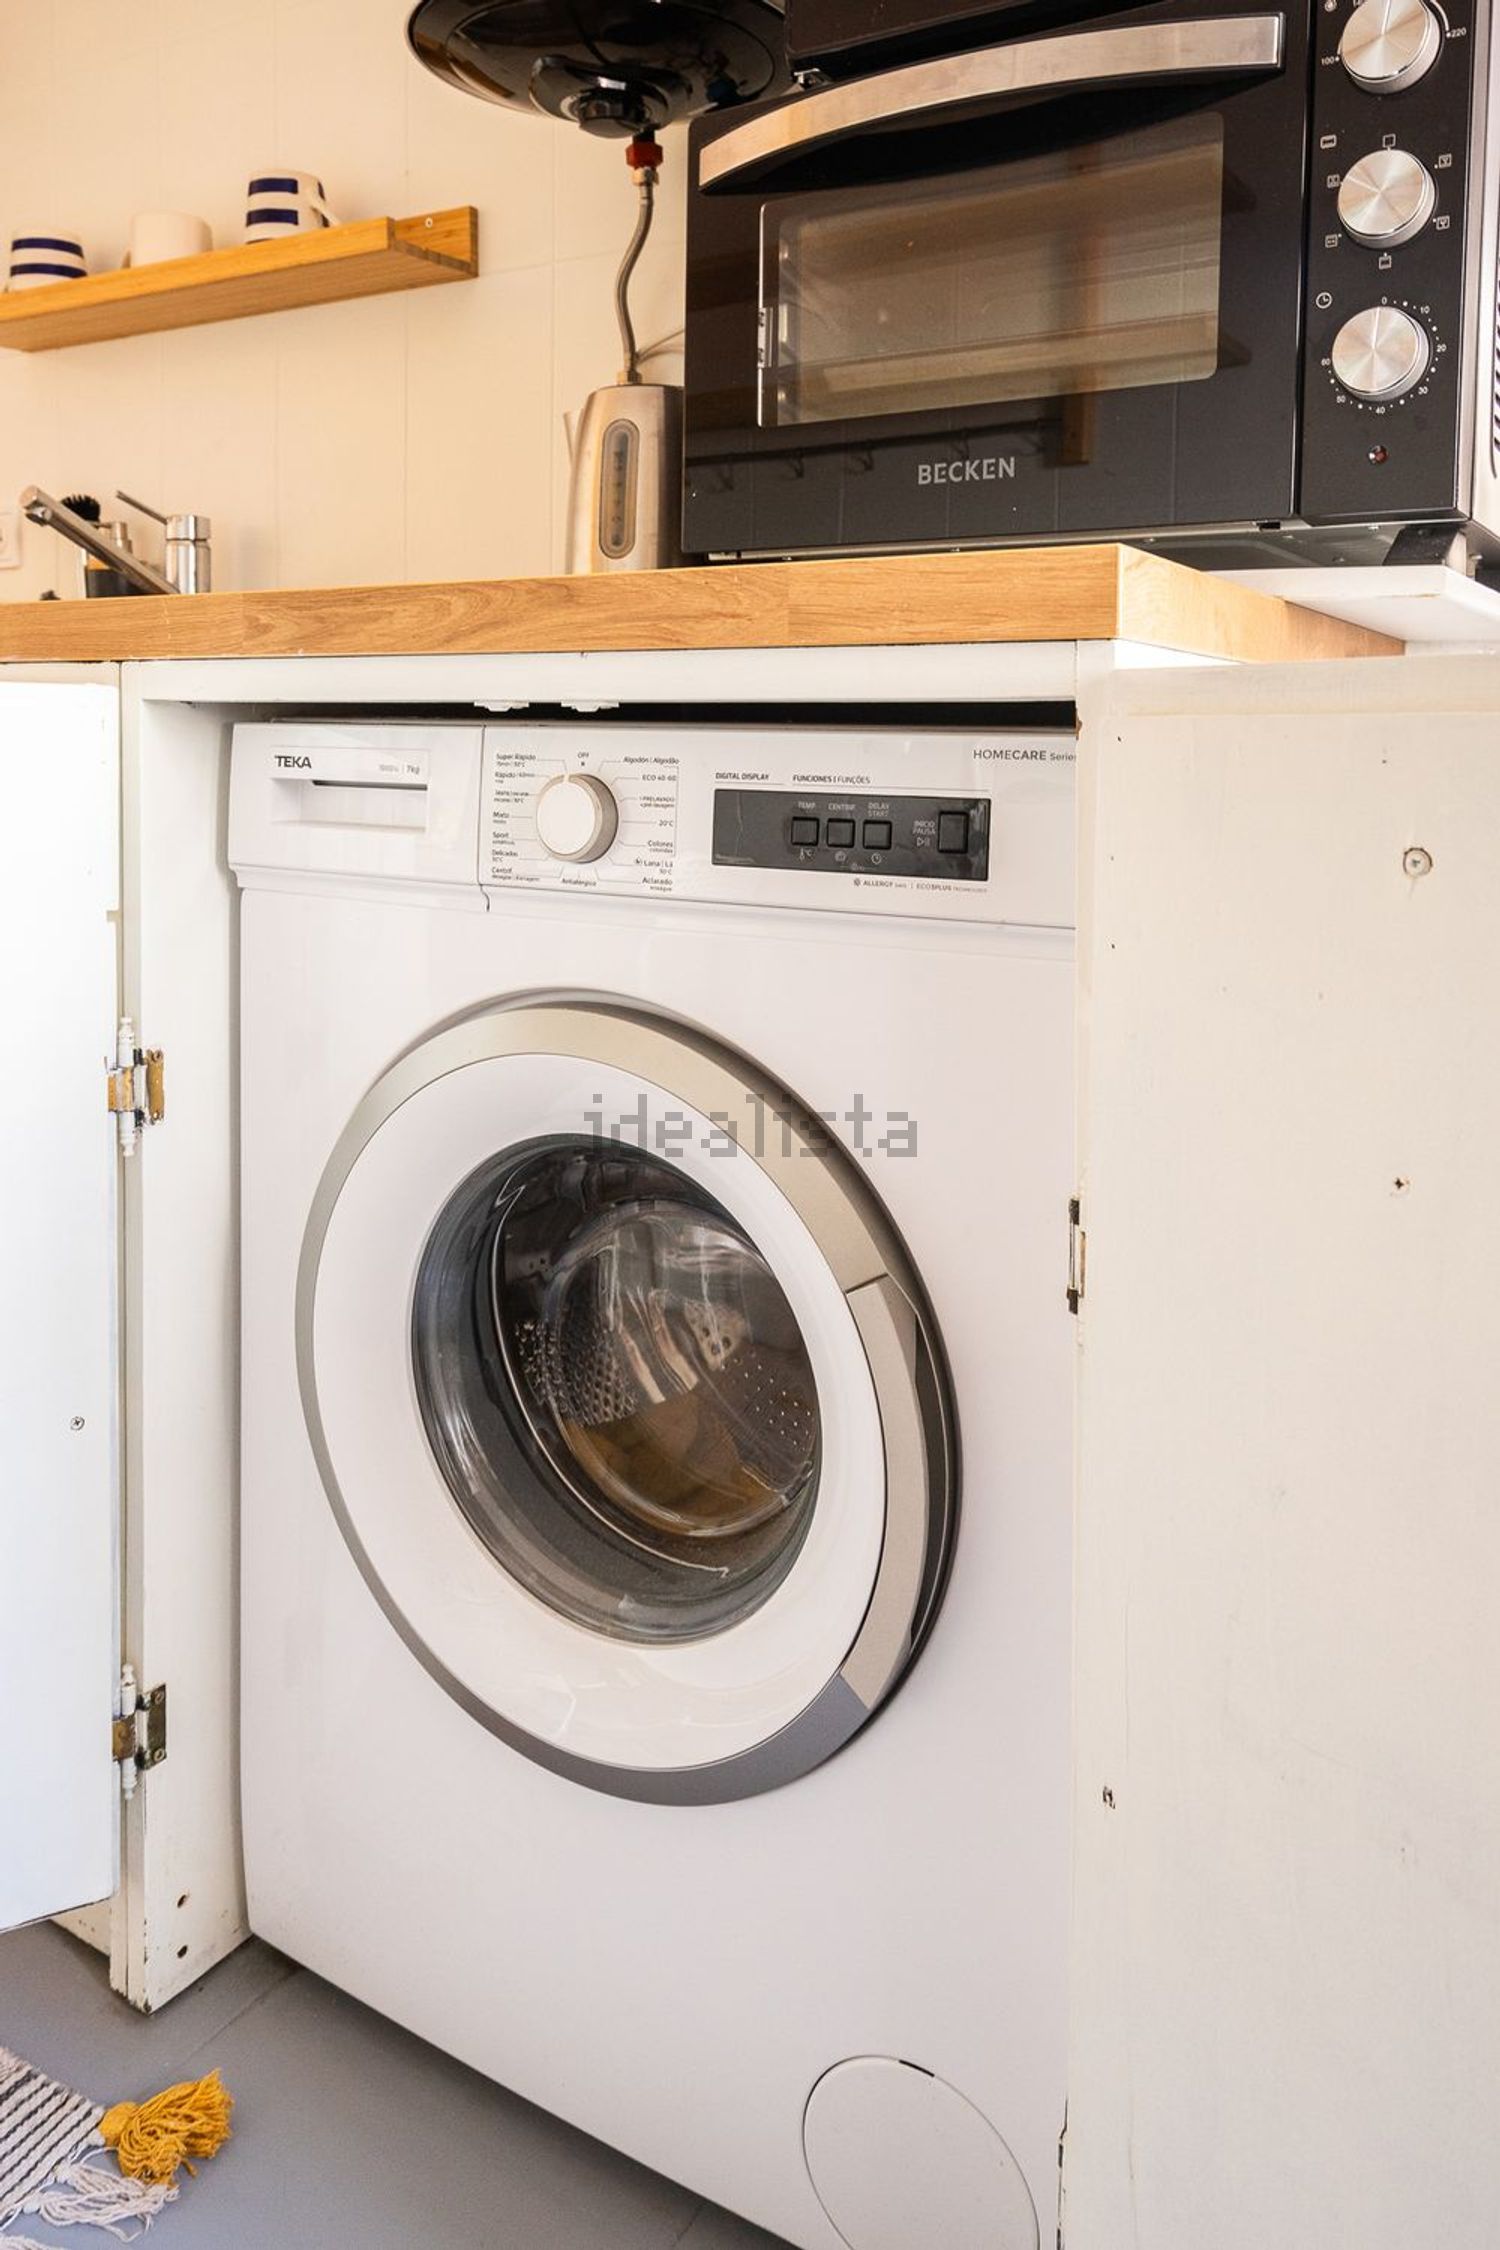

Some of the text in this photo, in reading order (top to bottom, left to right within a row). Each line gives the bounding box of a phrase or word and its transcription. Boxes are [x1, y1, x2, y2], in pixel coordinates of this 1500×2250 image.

[1450, 27, 1467, 38] 220
[1321, 56, 1335, 65] 100
[1381, 297, 1388, 305] 0
[1420, 306, 1431, 315] 10
[1436, 344, 1447, 352] 20
[1418, 386, 1428, 395] 30
[1375, 406, 1386, 414] 40
[918, 456, 1016, 485] BECKEN
[973, 749, 1048, 760] HOMECARE
[275, 755, 312, 769] TEKA
[623, 756, 649, 765] Algodón
[715, 772, 769, 781] DIGITAL DISPLAY
[793, 774, 871, 785] FUNCIONES FUNÇÕES
[867, 802, 889, 810] DELAY
[642, 877, 673, 885] Aclarado
[863, 879, 894, 887] ALLERGY
